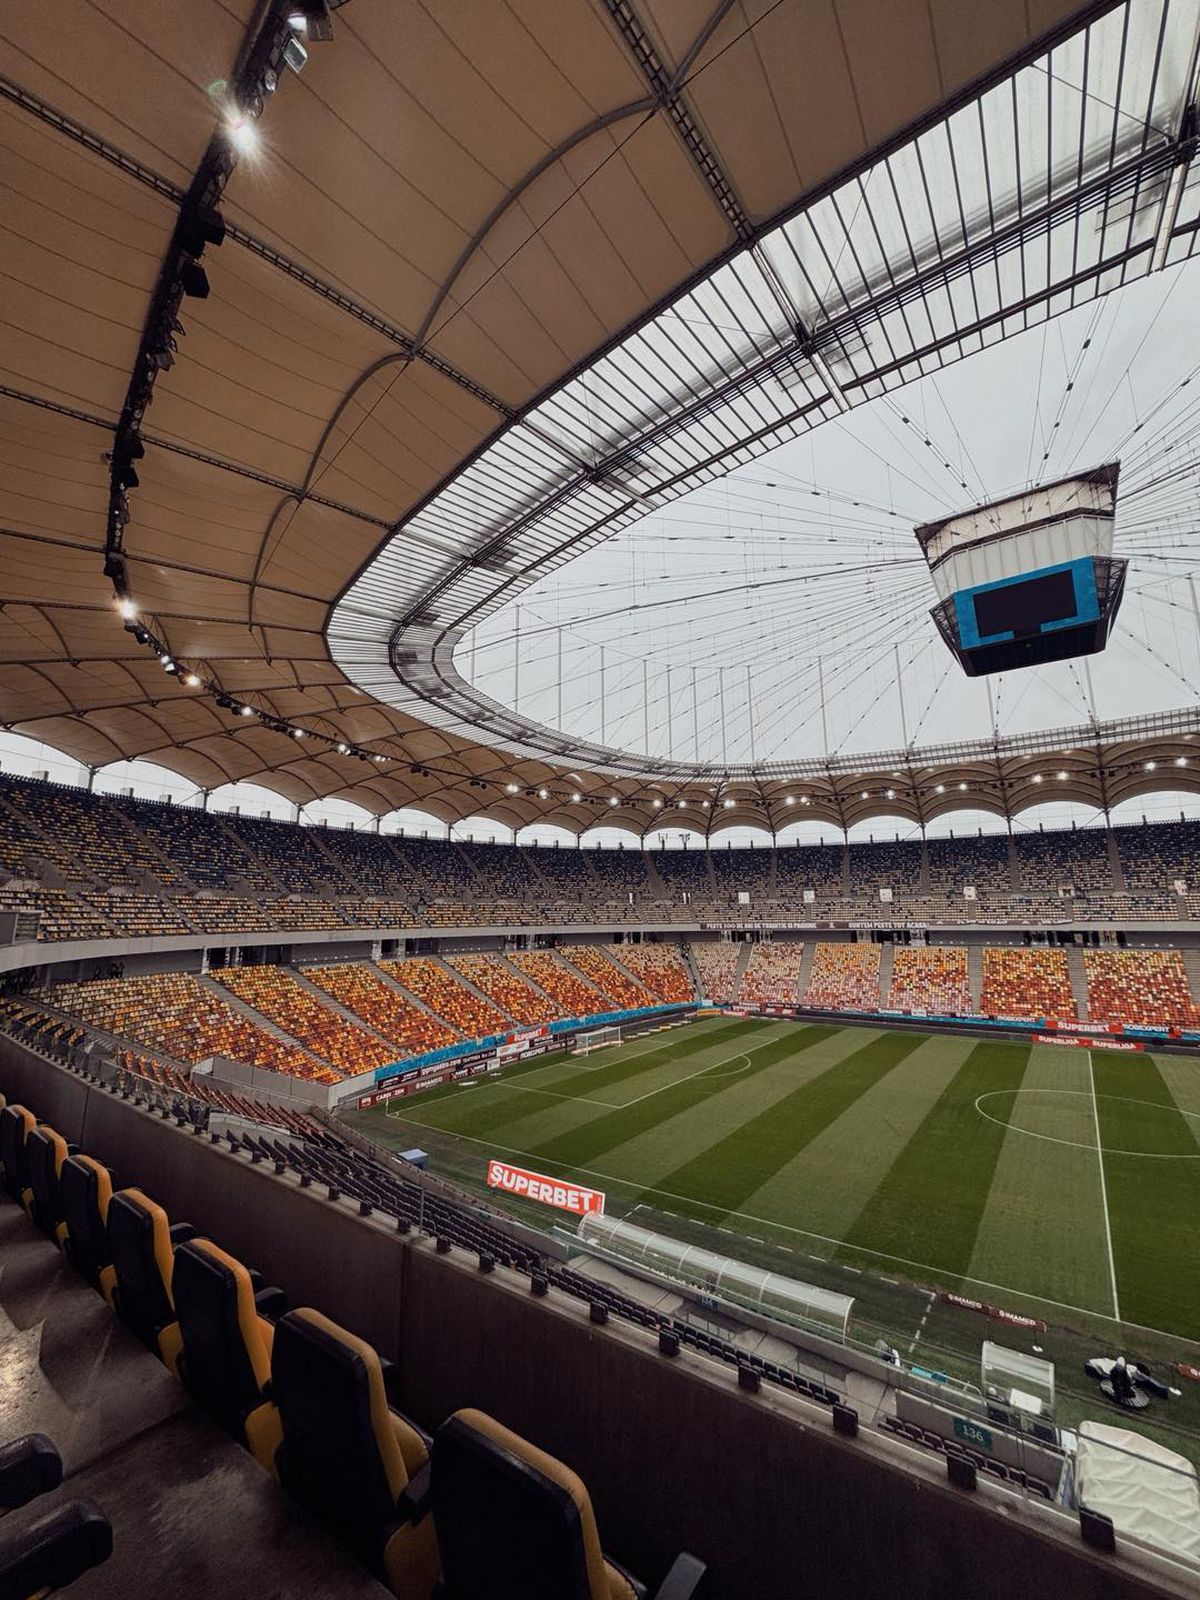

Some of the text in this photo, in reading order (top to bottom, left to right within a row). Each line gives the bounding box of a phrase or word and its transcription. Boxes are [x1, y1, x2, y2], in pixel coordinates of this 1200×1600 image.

[1057, 1020, 1110, 1033] SUPERBET
[1038, 1035, 1080, 1045] SUPERLIGA
[1092, 1040, 1137, 1050] SUPERLIGA
[490, 1165, 593, 1211] SUPERBET
[963, 1424, 984, 1441] 136
